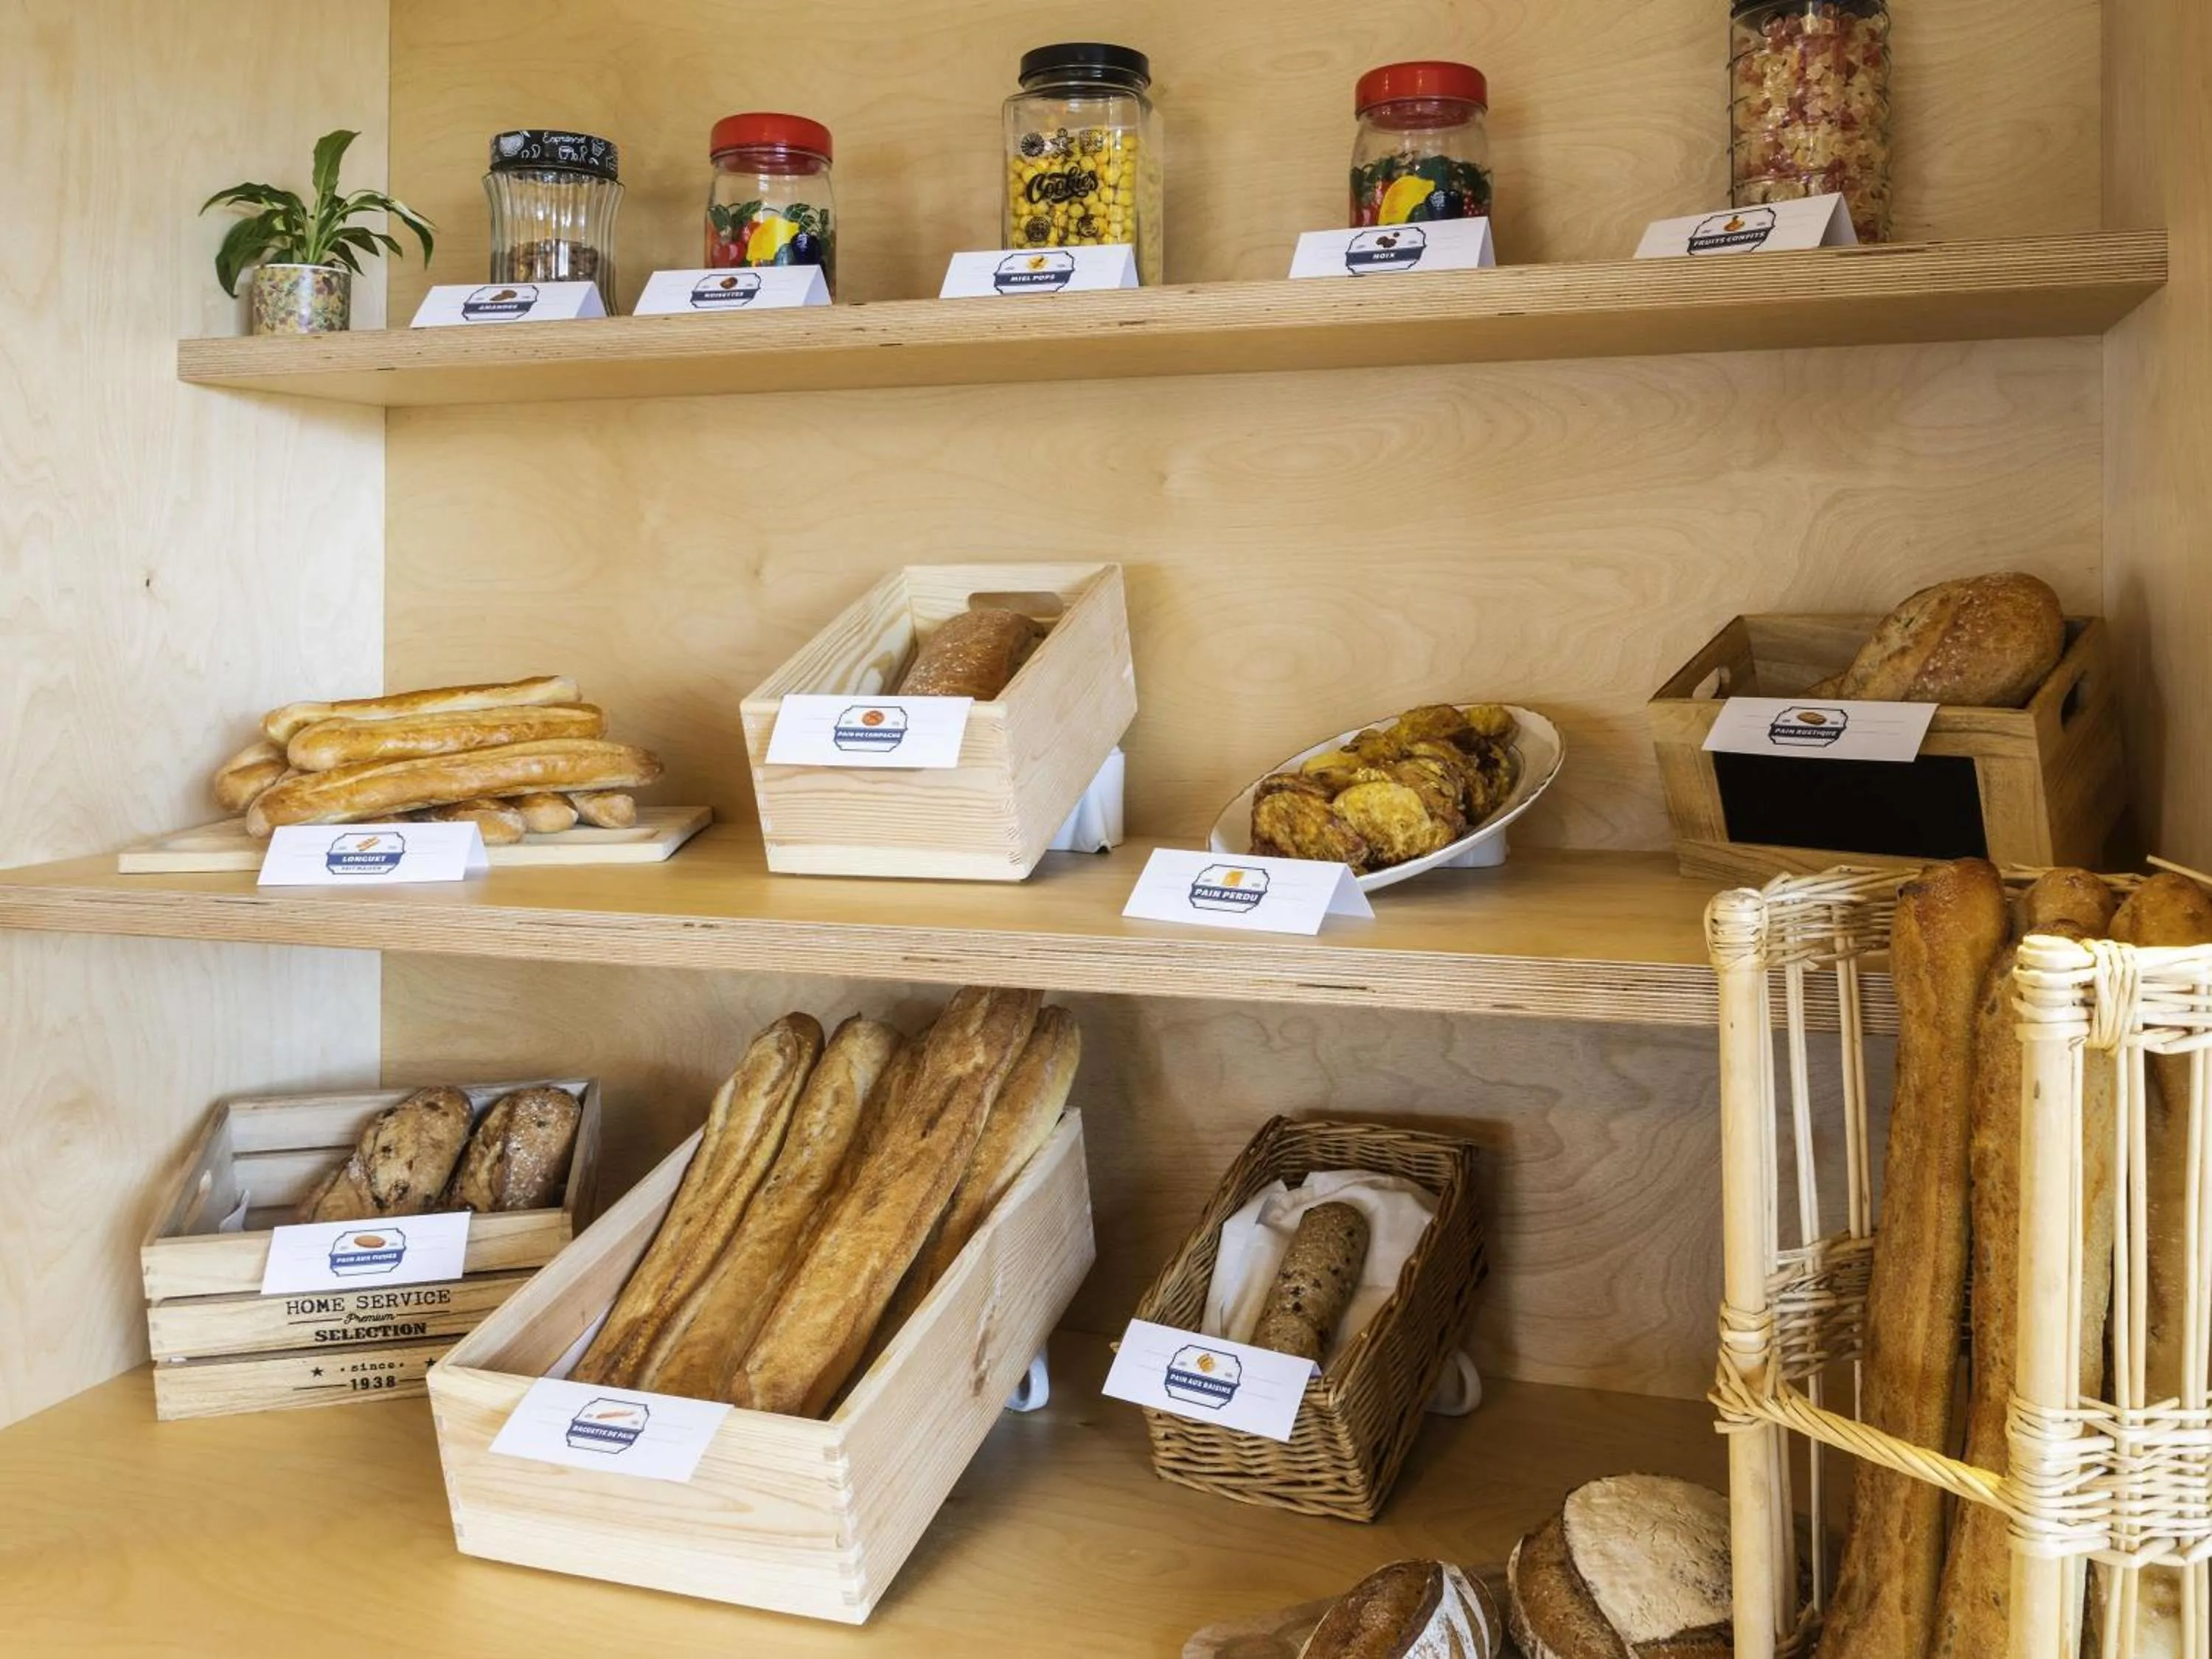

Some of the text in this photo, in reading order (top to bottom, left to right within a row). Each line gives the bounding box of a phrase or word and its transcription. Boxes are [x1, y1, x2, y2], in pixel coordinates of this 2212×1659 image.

[1194, 888, 1259, 902] PAIN PERDU
[285, 1290, 451, 1315] HOME SERVICE
[343, 1312, 396, 1325] Premium
[314, 1322, 427, 1343] SELECTION
[350, 1361, 395, 1373] since
[350, 1375, 397, 1391] 1938
[1170, 1374, 1188, 1382] PAIN
[1188, 1378, 1203, 1387] AUX
